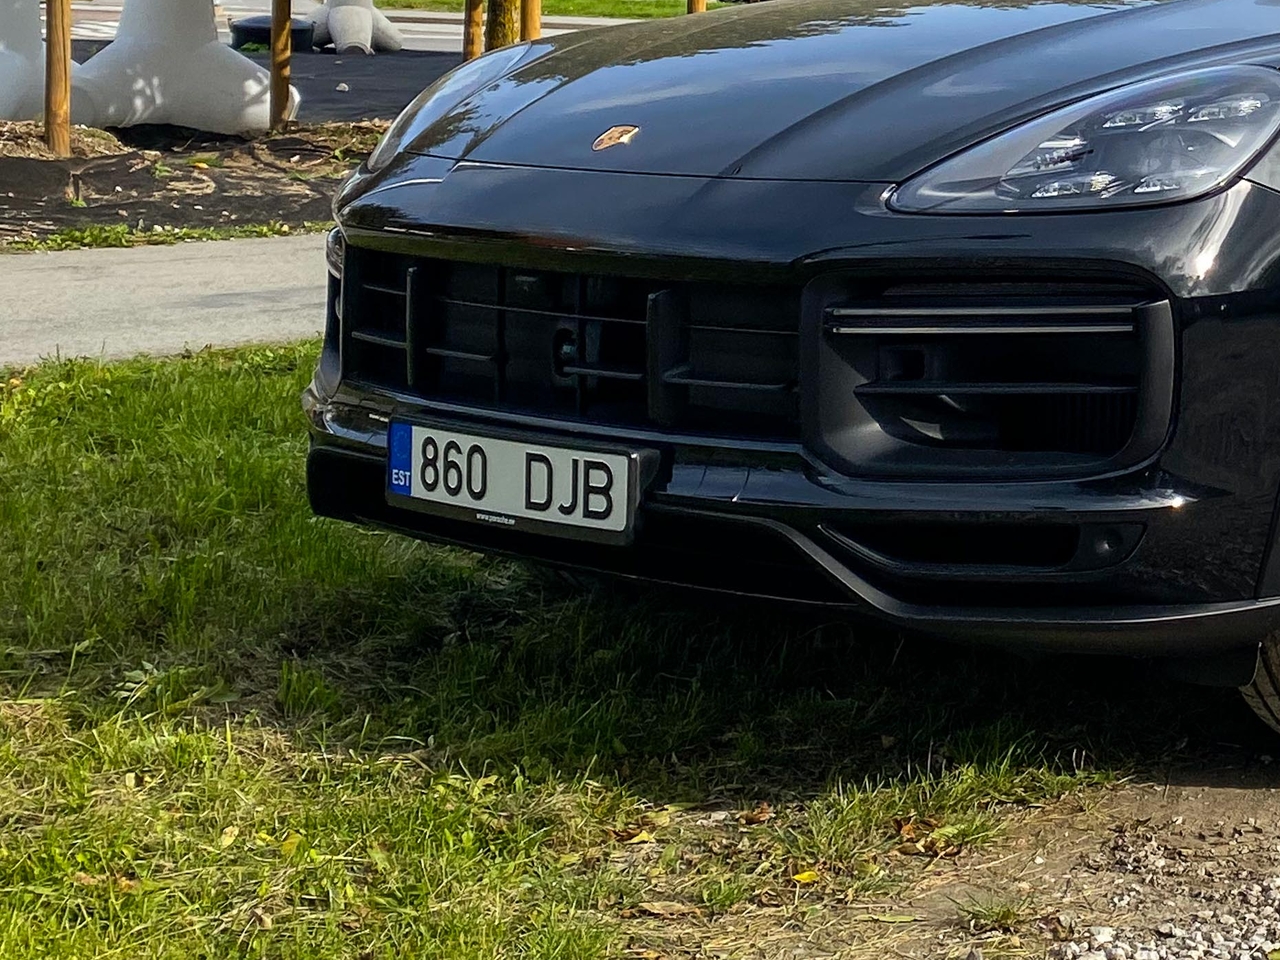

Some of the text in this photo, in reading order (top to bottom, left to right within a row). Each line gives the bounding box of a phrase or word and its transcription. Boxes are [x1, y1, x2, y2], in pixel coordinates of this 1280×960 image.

[392, 469, 411, 487] EST
[420, 435, 614, 521] 860 DJB
